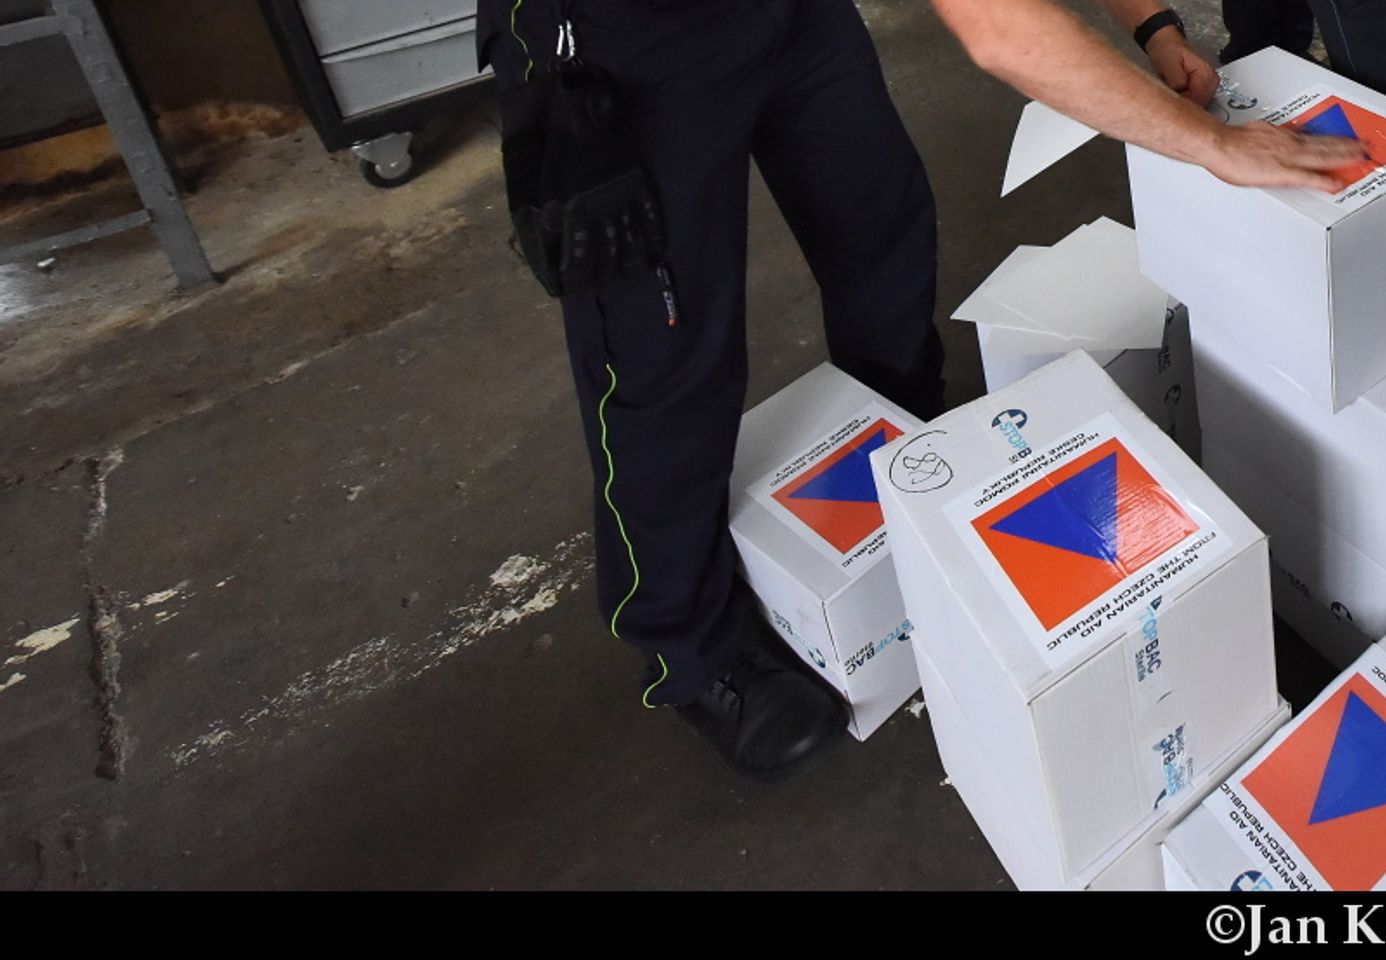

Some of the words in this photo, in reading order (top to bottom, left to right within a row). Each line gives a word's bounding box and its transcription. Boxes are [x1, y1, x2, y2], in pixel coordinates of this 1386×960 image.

[1181, 531, 1217, 556] FROM
[1157, 554, 1181, 574] THE
[1106, 553, 1200, 621] HUMANITARIAN
[1113, 573, 1155, 605] CZECH
[1046, 603, 1111, 651] REPUBLIC
[1080, 620, 1102, 639] AID
[1220, 782, 1265, 833] REPUBLIC
[1229, 810, 1248, 830] AID
[1246, 829, 1301, 891] ANITARIAN
[1262, 831, 1298, 872] CZECH
